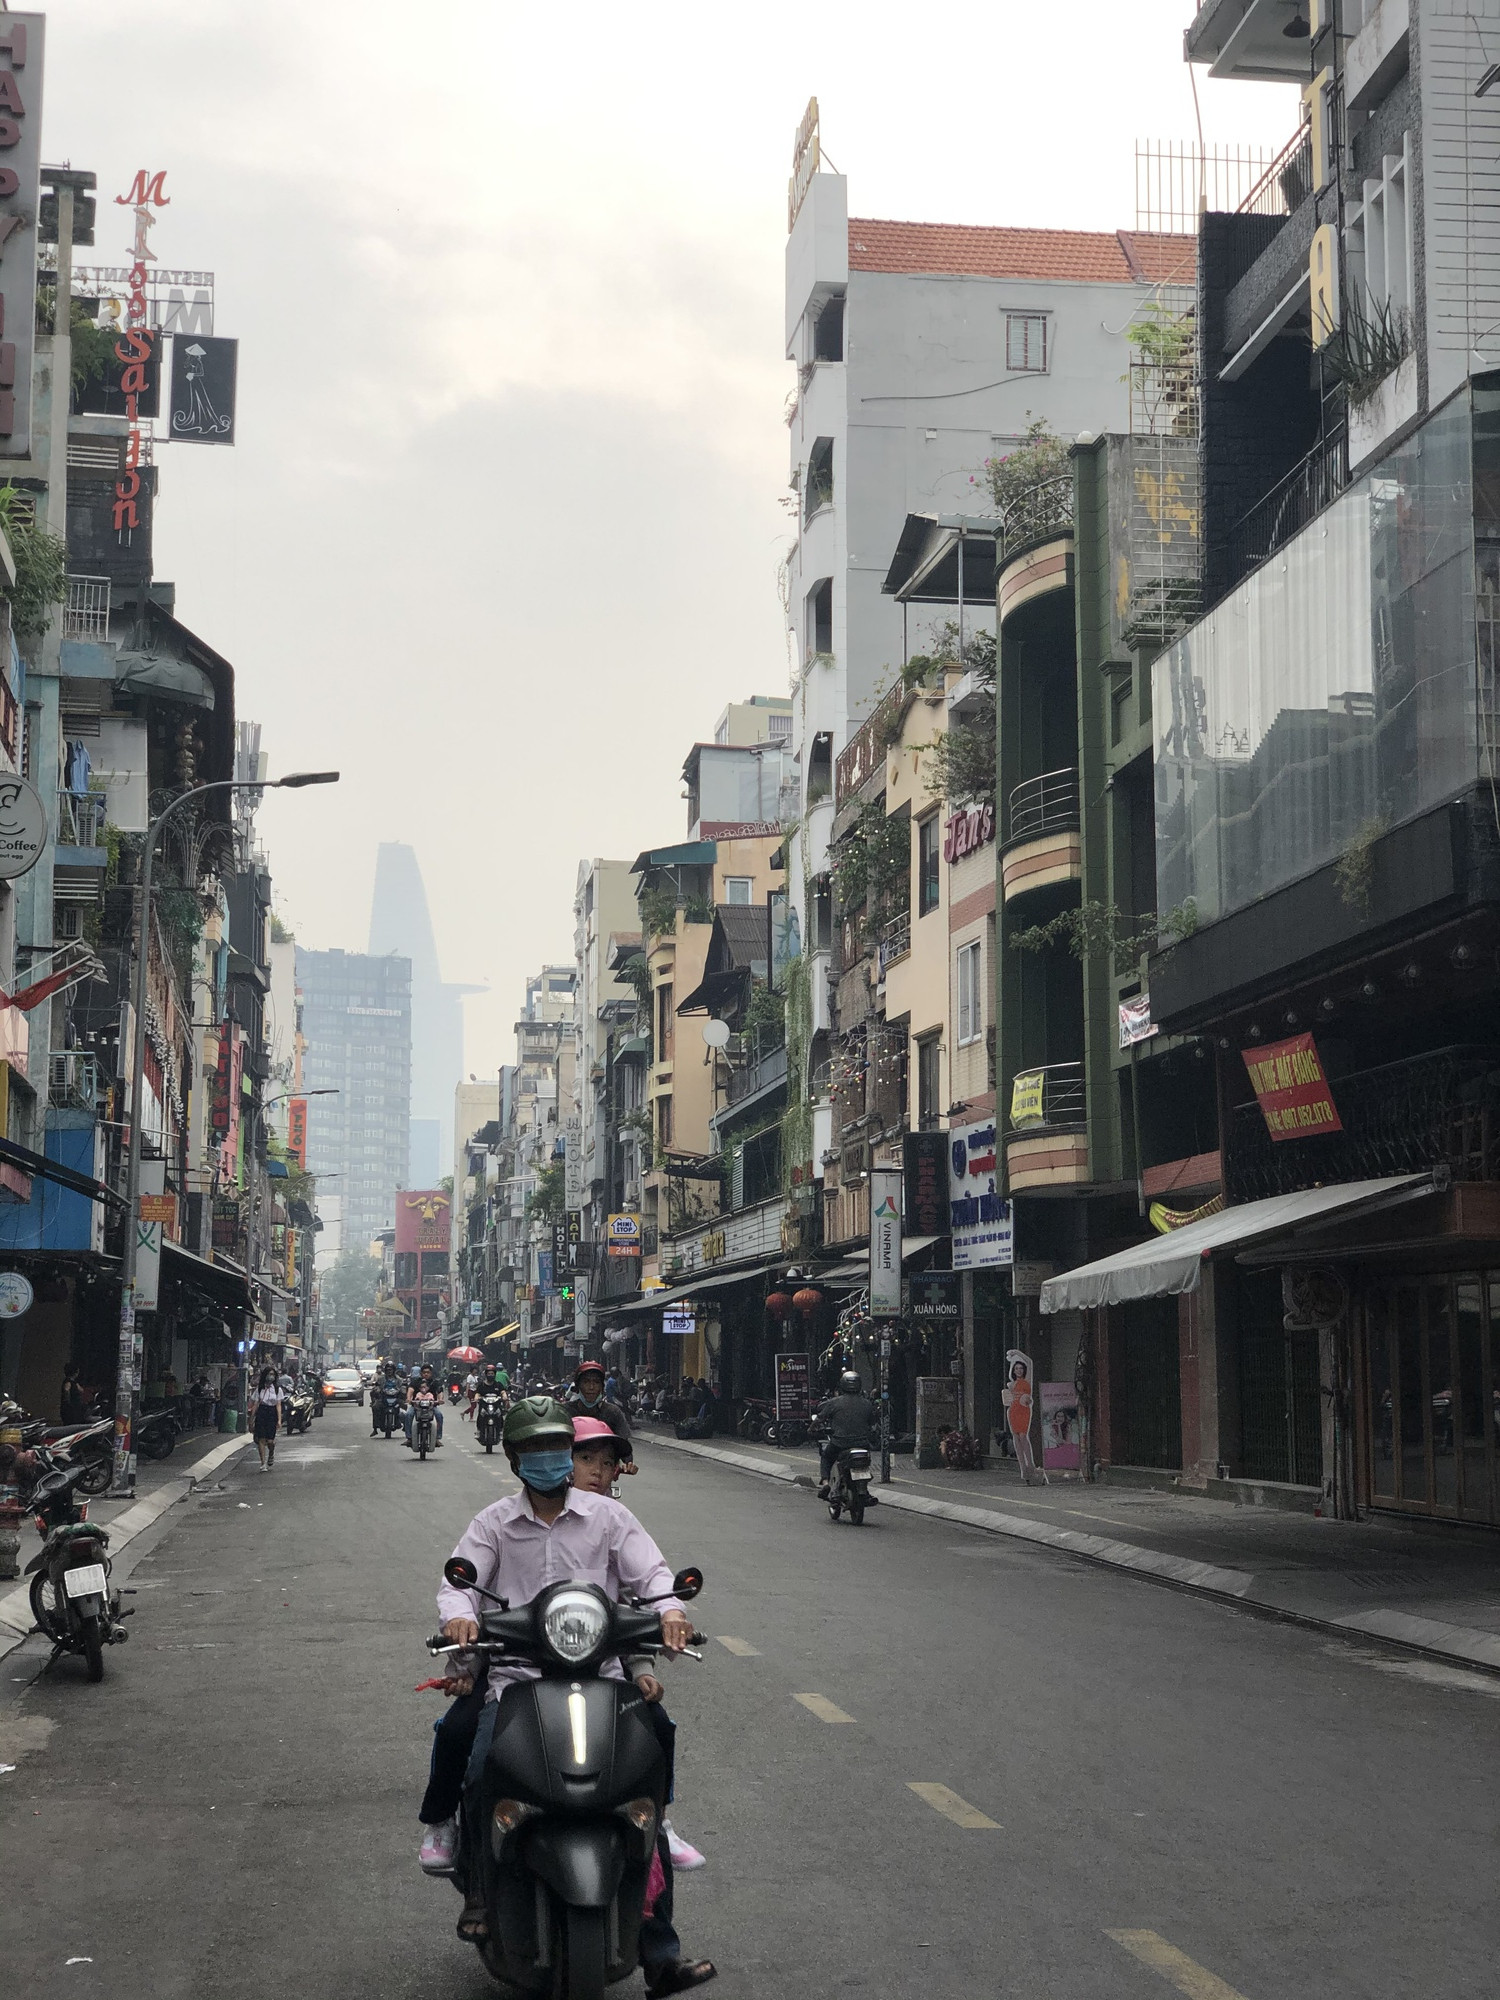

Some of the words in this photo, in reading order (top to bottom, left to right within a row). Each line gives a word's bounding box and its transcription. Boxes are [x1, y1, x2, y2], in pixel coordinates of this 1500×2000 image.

[566, 1132, 581, 1209] HOTEL
[616, 1246, 633, 1255] 24H
[883, 1222, 892, 1270] VINAMA
[257, 1331, 272, 1341] 148
